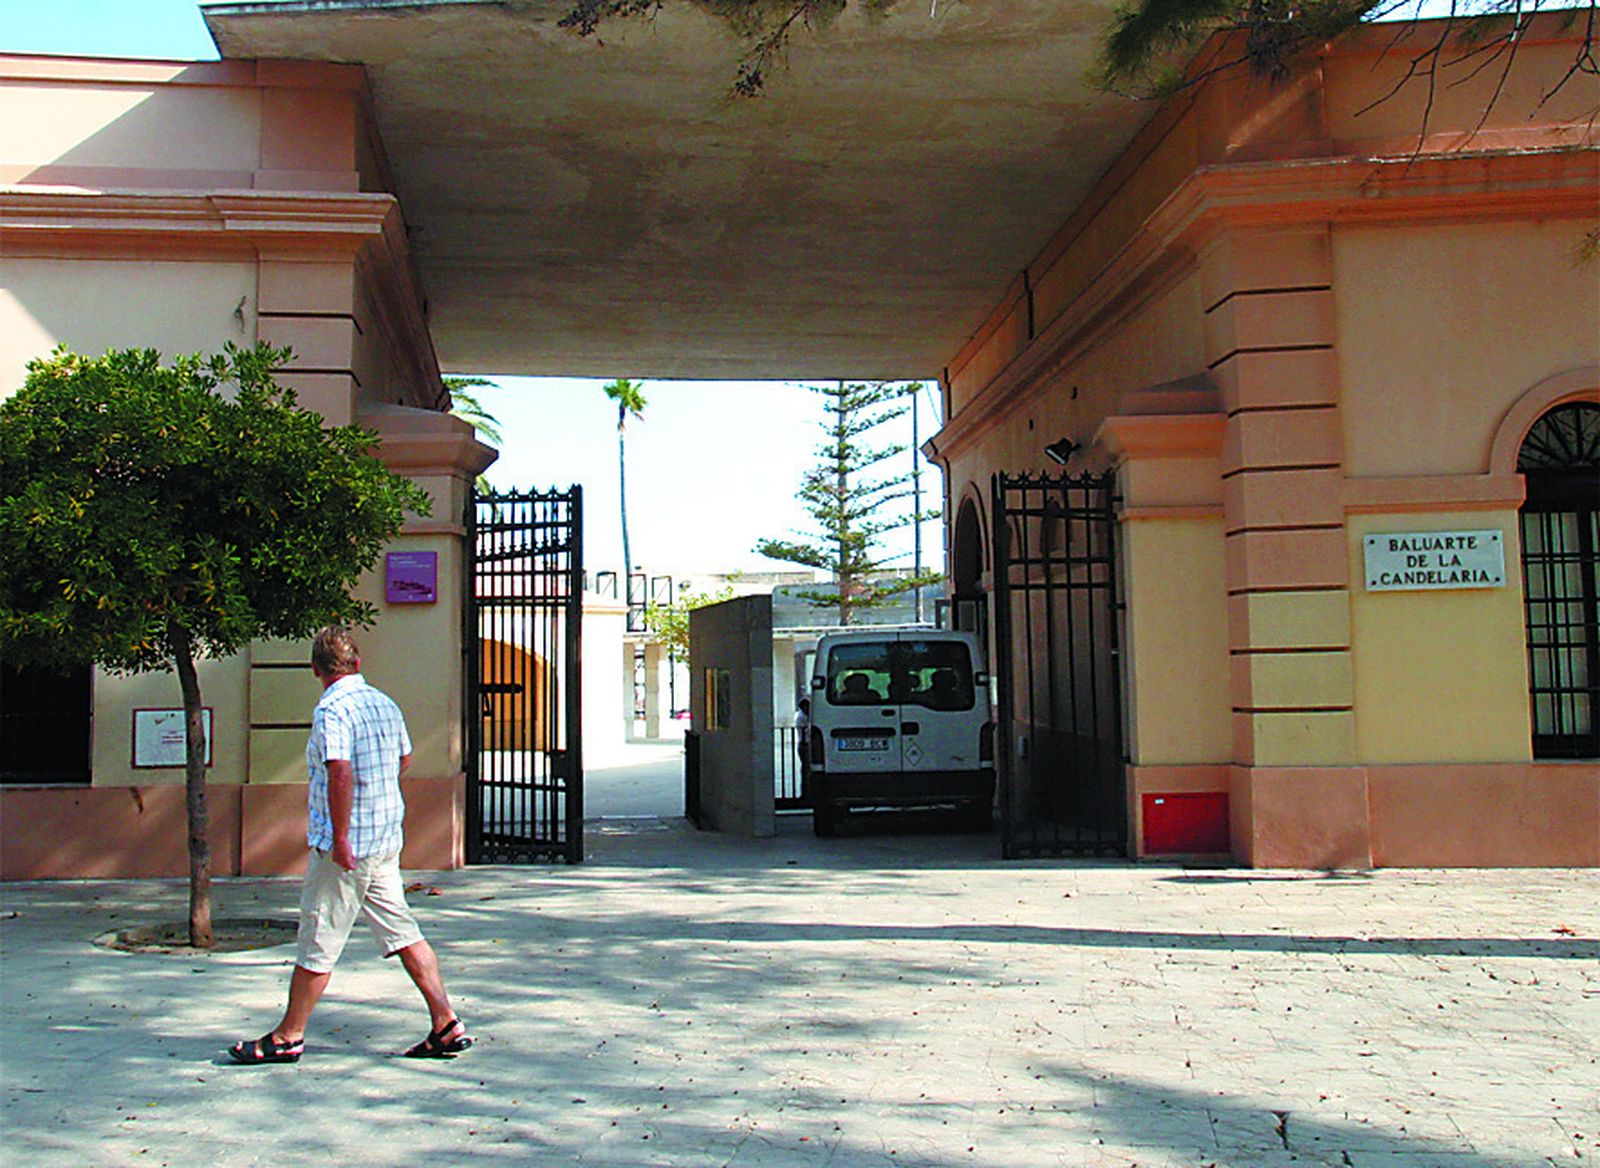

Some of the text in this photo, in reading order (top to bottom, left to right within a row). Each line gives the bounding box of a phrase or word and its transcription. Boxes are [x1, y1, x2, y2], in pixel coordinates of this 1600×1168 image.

[1389, 536, 1478, 552] BALUARTE
[1407, 554, 1462, 568] DE LA
[1380, 569, 1490, 585] CANDELARIA
